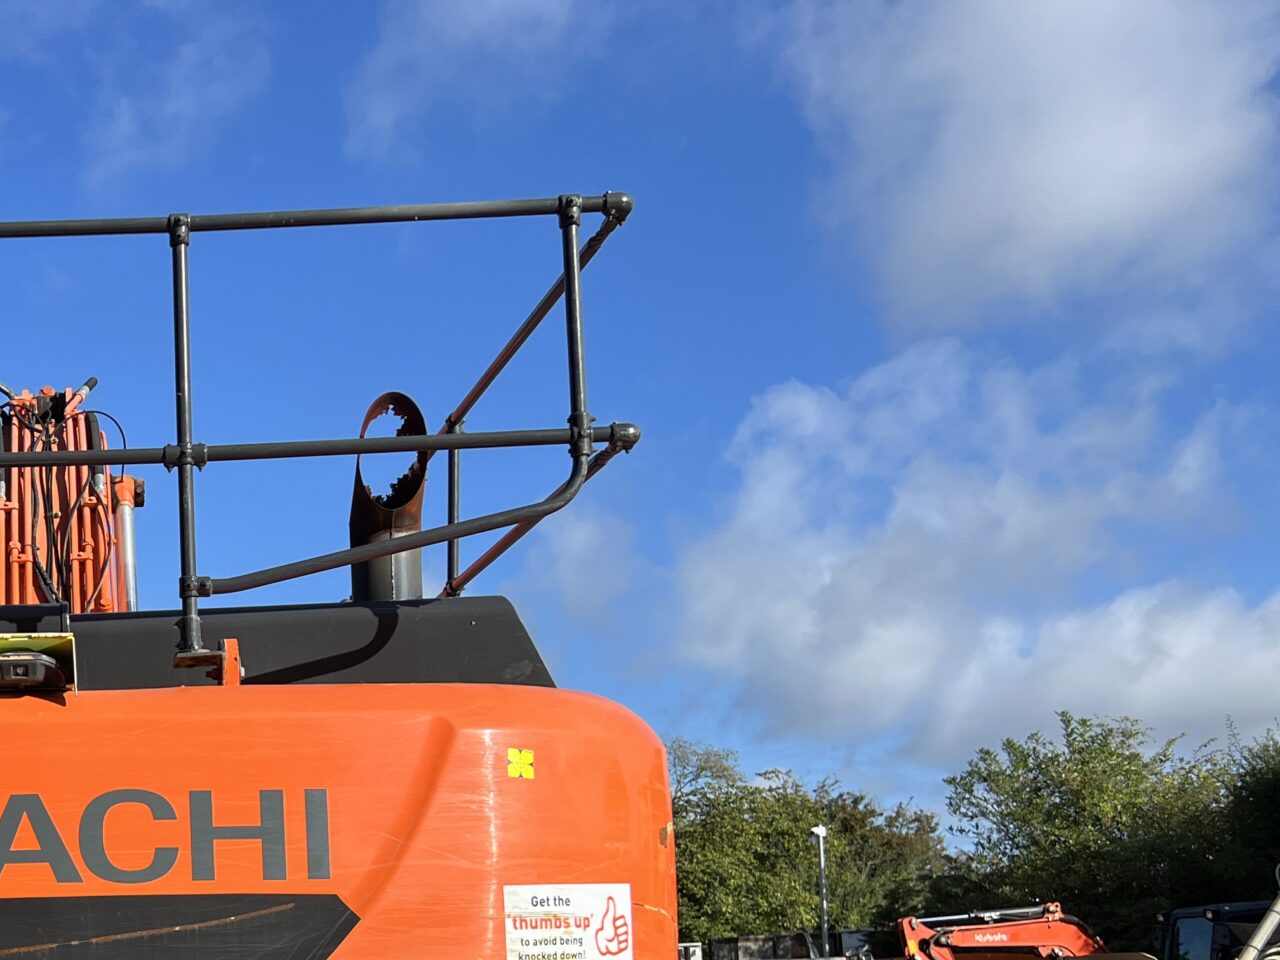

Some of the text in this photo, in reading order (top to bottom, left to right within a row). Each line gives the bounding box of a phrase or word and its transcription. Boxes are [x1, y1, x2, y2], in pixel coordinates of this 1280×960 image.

[530, 895, 571, 907] Get the
[520, 936, 583, 947] to avoid being
[559, 950, 587, 960] down!
